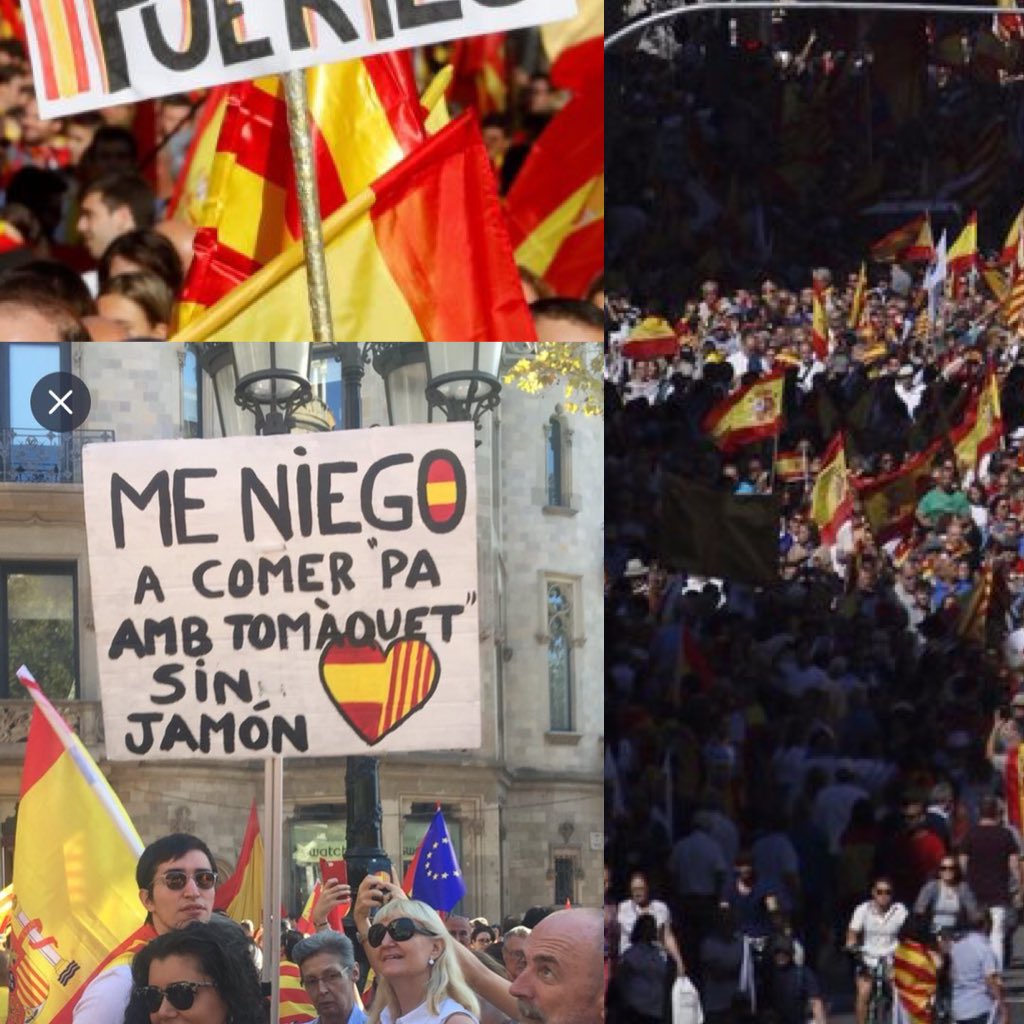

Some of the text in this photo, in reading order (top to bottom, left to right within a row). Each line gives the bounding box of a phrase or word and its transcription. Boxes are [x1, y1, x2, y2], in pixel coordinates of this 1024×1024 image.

[110, 467, 219, 549] ME
[134, 565, 166, 604] A
[192, 551, 356, 599] COMER
[108, 616, 213, 660] AMB
[124, 700, 309, 755] JAMÓN
